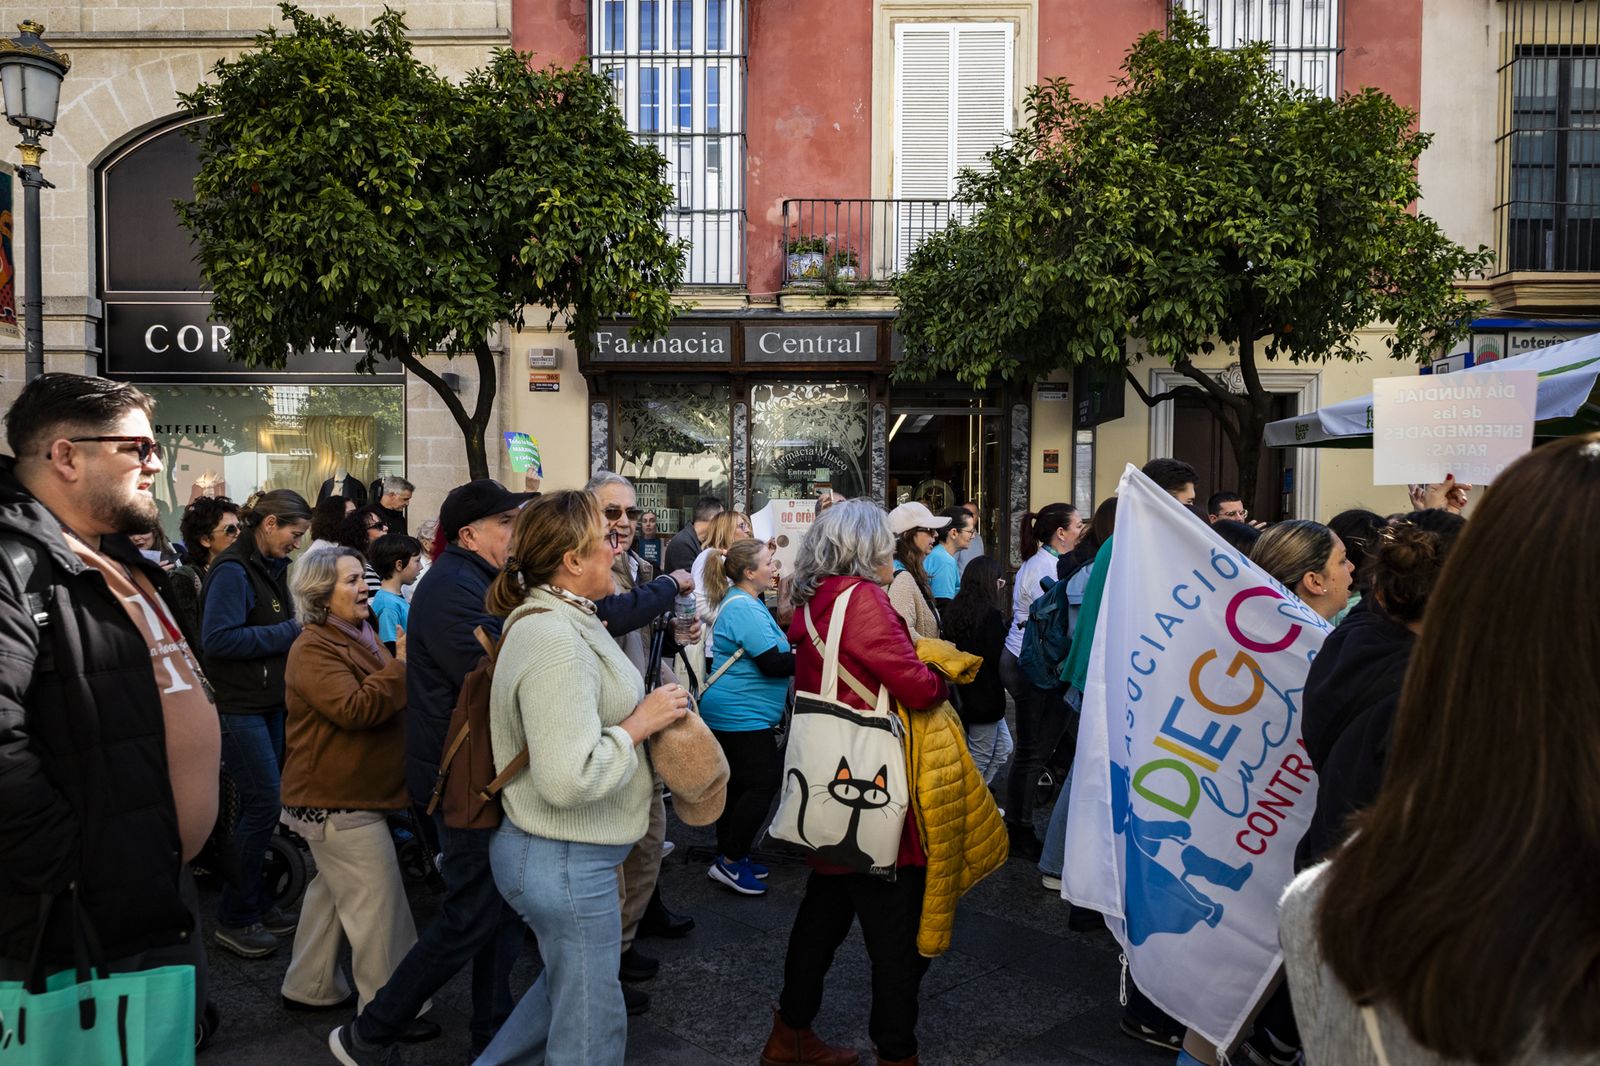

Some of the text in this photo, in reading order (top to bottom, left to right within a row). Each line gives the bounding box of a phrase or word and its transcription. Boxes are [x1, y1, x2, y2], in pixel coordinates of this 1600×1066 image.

[596, 331, 862, 354] Farmacia Central
[1512, 335, 1570, 350] Lotería
[155, 424, 220, 435] RTEFIEL
[1124, 548, 1250, 757] ASOCIACIÓ
